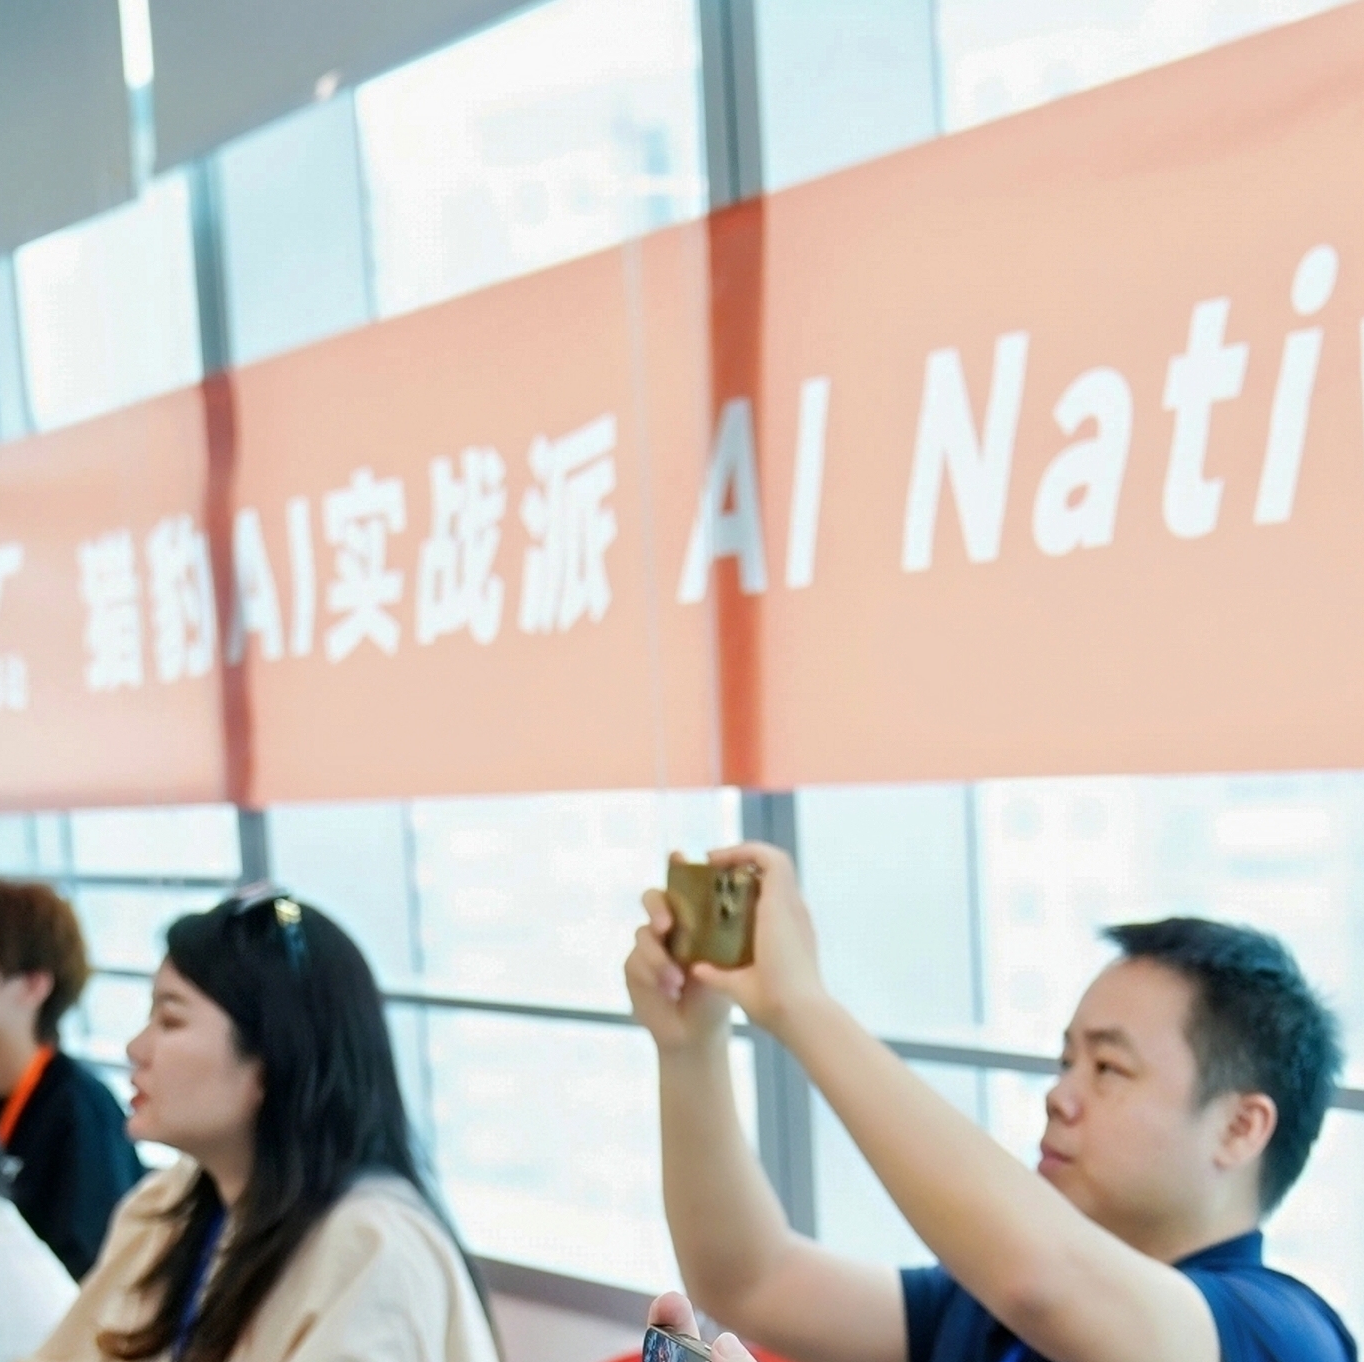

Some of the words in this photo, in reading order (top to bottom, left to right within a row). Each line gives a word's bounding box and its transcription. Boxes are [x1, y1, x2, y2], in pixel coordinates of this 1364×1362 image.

[76, 413, 617, 692] 猎豹AI实战派
[678, 377, 830, 604] AI
